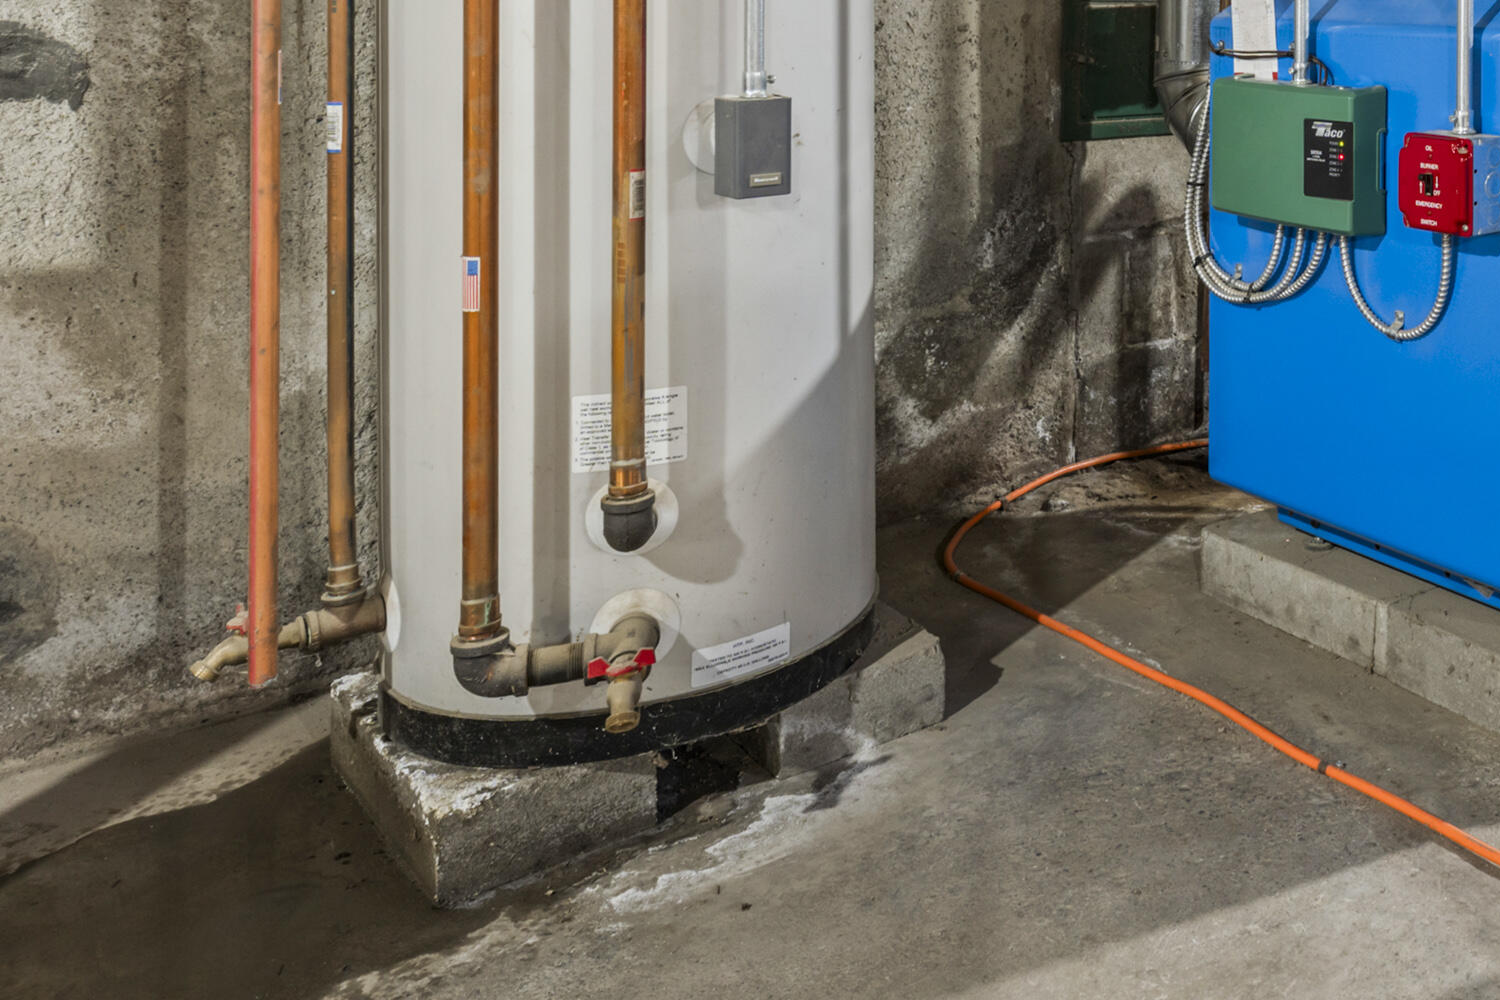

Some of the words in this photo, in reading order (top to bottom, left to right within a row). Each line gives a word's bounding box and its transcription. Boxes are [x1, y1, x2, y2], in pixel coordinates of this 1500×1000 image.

[1311, 121, 1344, 138] Taco
[1420, 162, 1439, 170] BURNER
[1415, 200, 1443, 209] EMERGENCY
